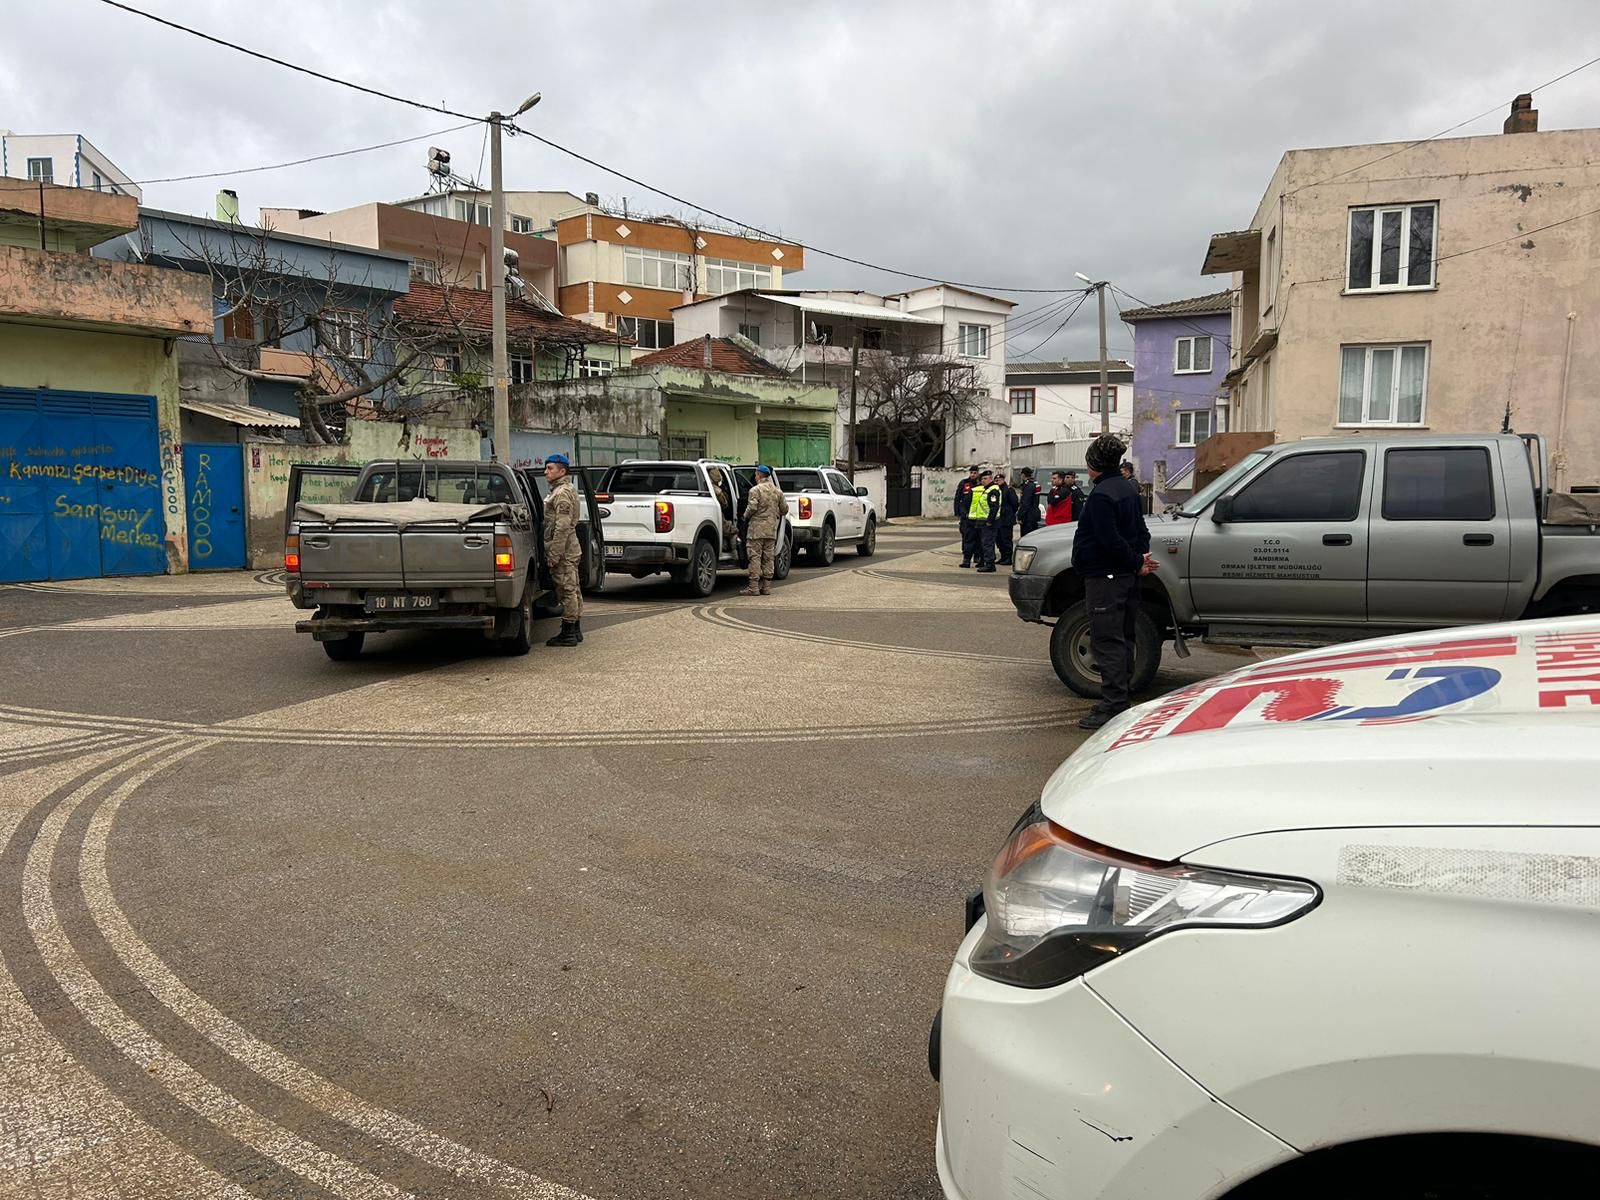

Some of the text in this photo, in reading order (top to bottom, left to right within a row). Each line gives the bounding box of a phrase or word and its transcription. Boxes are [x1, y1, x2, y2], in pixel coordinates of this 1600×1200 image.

[375, 595, 432, 609] 10 NT 760
